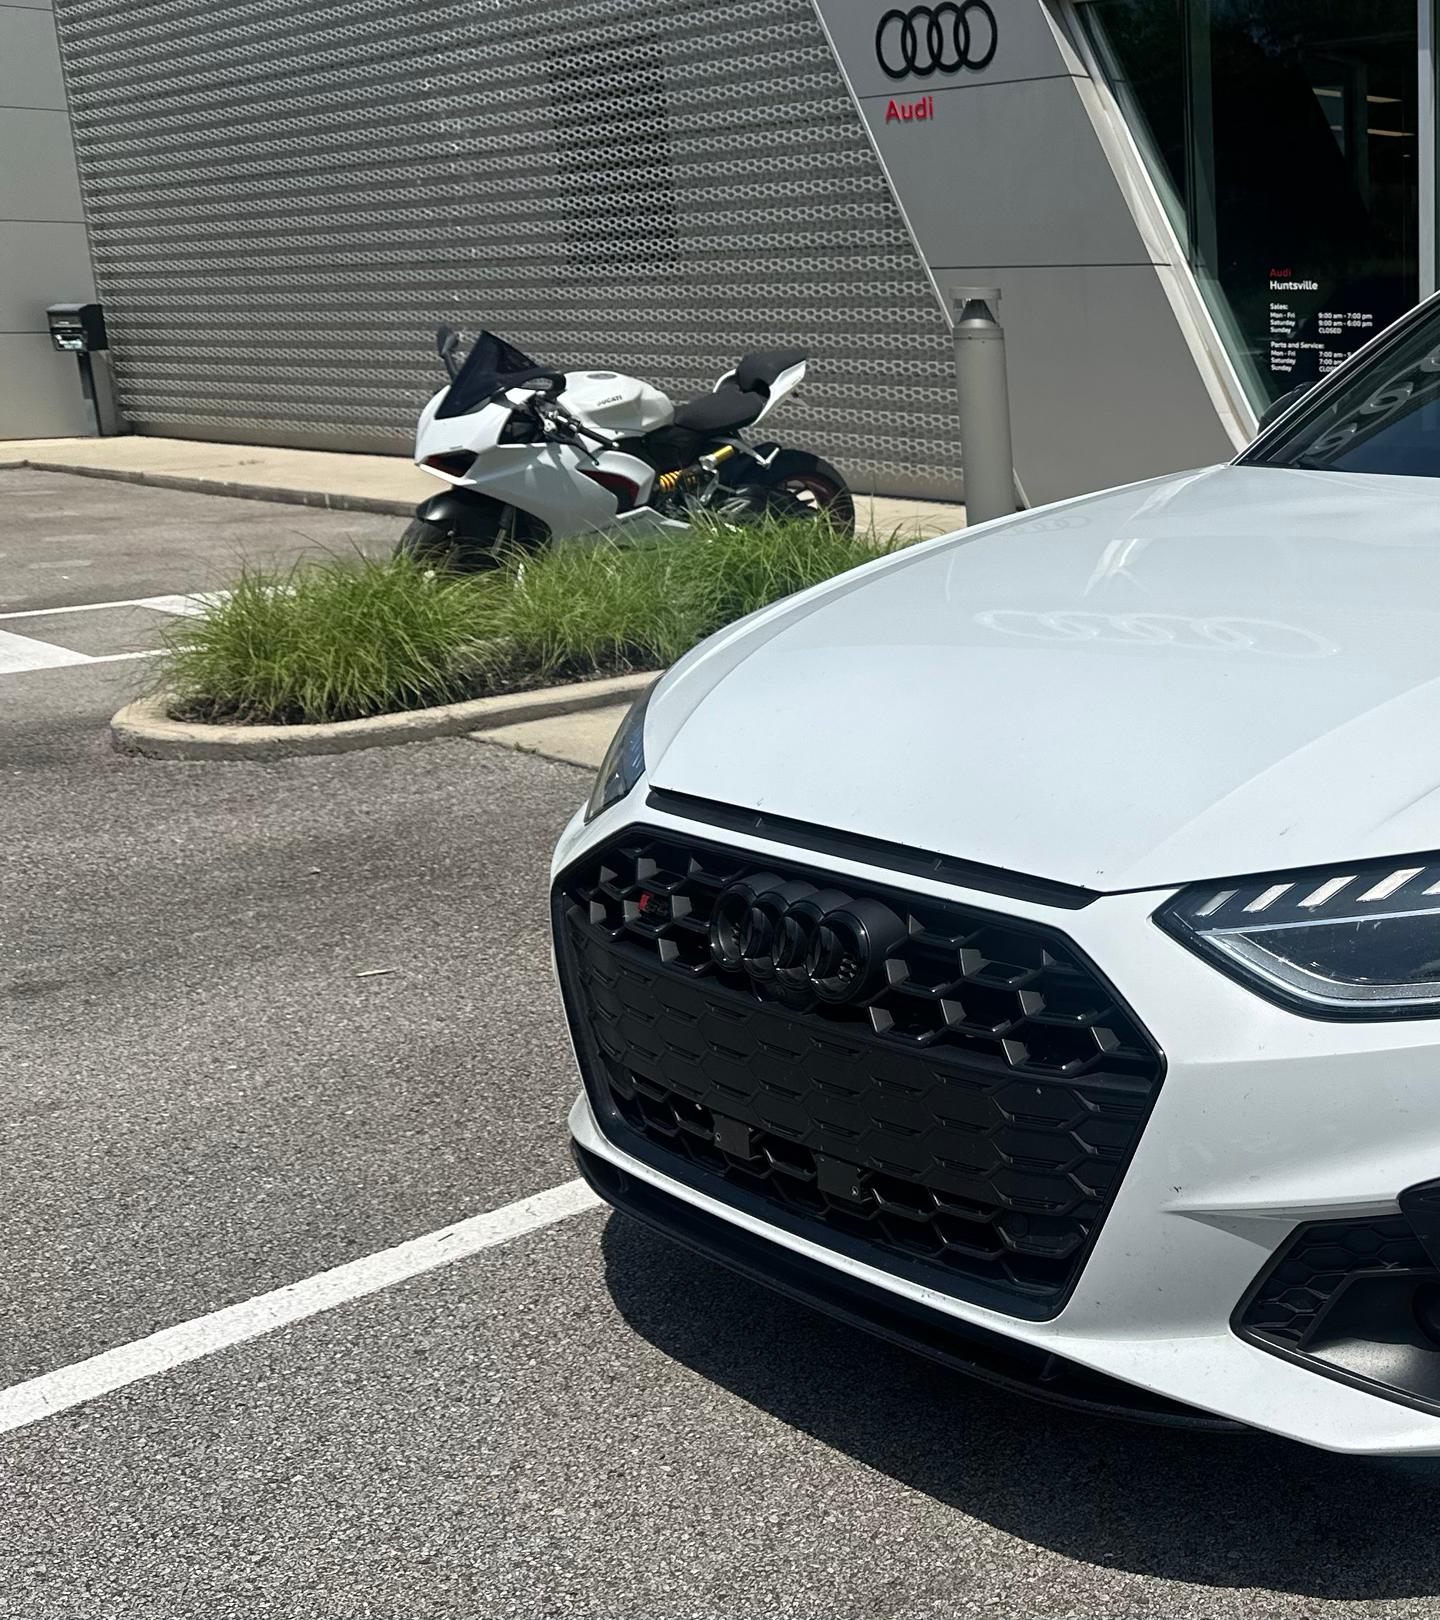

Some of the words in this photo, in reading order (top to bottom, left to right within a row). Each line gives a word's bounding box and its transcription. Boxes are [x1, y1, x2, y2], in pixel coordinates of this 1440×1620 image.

[885, 96, 934, 125] Audi
[1269, 268, 1292, 277] Audi
[1269, 280, 1319, 290] Huntsville
[1269, 319, 1296, 327] Saturday
[1270, 357, 1296, 365] Saturday
